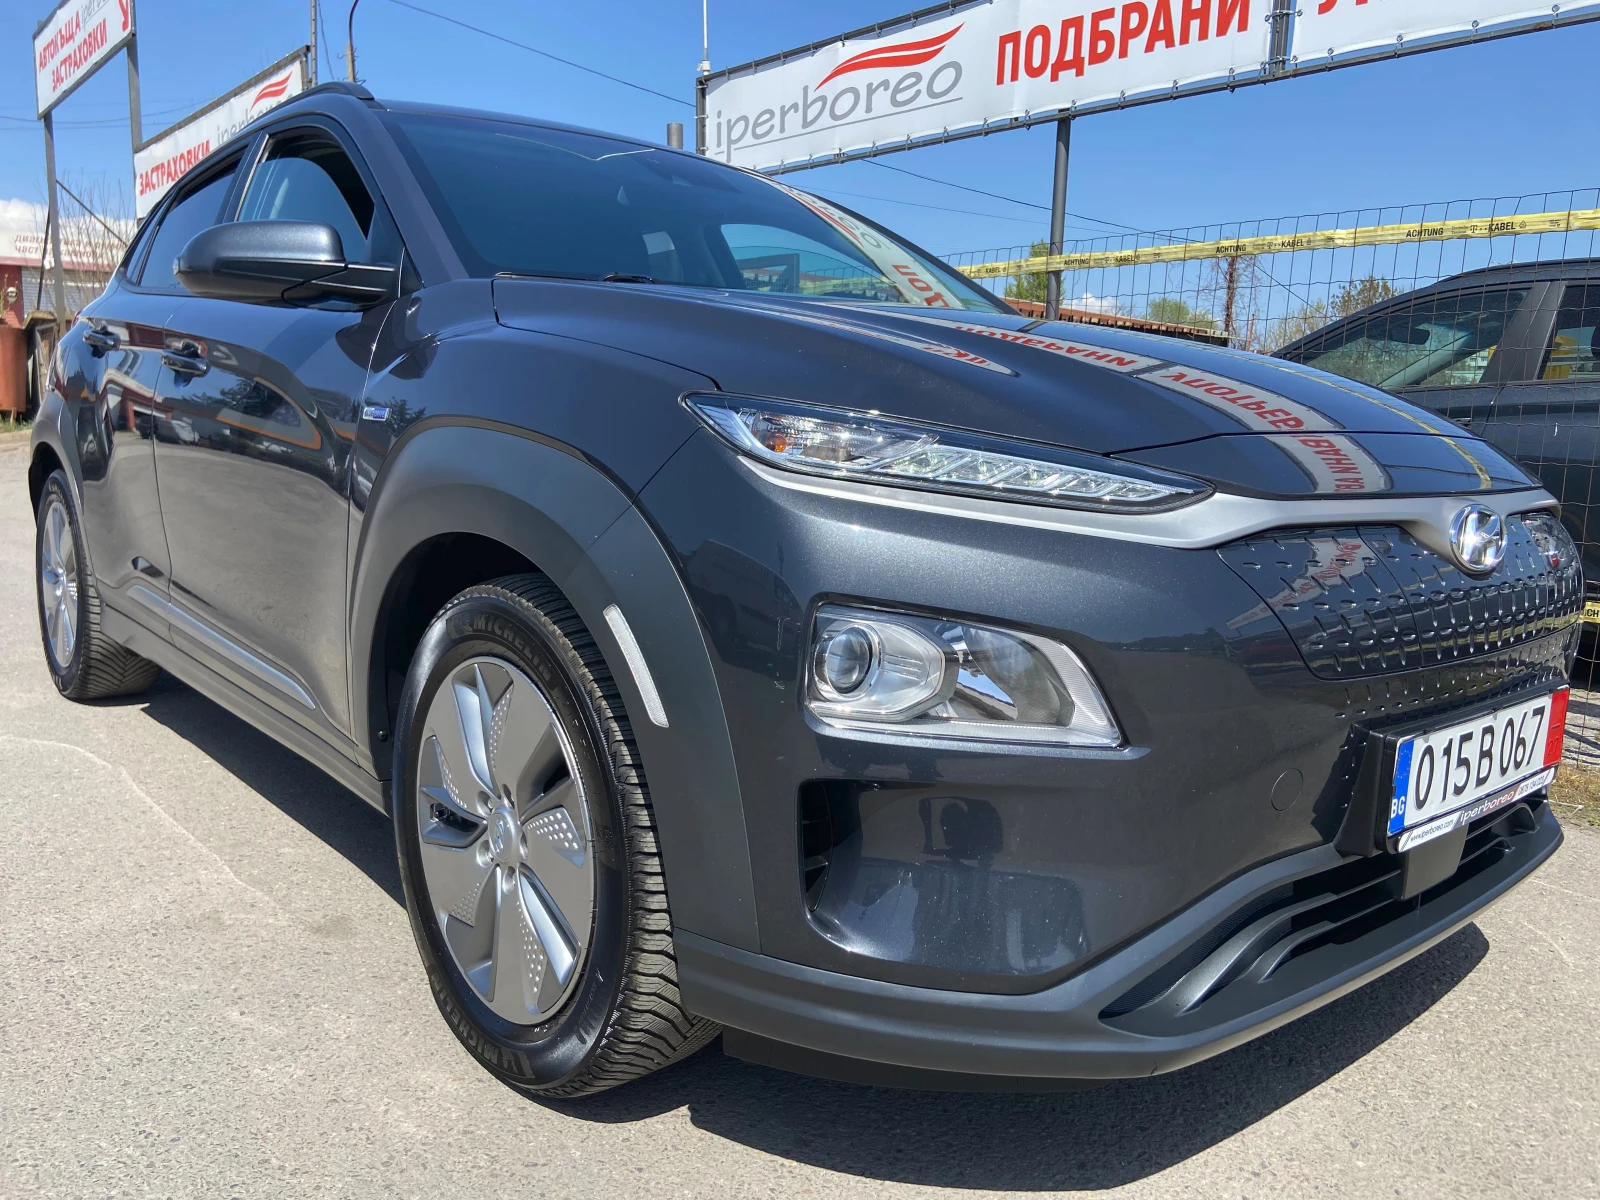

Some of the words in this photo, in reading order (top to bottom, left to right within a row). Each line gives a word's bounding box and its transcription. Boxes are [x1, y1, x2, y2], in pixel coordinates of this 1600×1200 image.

[39, 10, 81, 74] АВТОКЪЩА
[52, 17, 107, 92] ЗАСТРАХОВКИ
[996, 0, 1251, 86] ПОДБРАНИ
[715, 60, 964, 164] iperboreo
[1063, 258, 1090, 266] ACHTUNG
[1215, 244, 1247, 253] ACHTUNG
[1281, 240, 1305, 248] KABEL
[1405, 227, 1444, 238] ACHTUNG
[1487, 222, 1516, 232] KABEL
[473, 613, 552, 682] MICHELIN
[1391, 796, 1405, 819] BG
[1460, 790, 1515, 826] iperboreo
[431, 972, 500, 1065] MICHELIN
